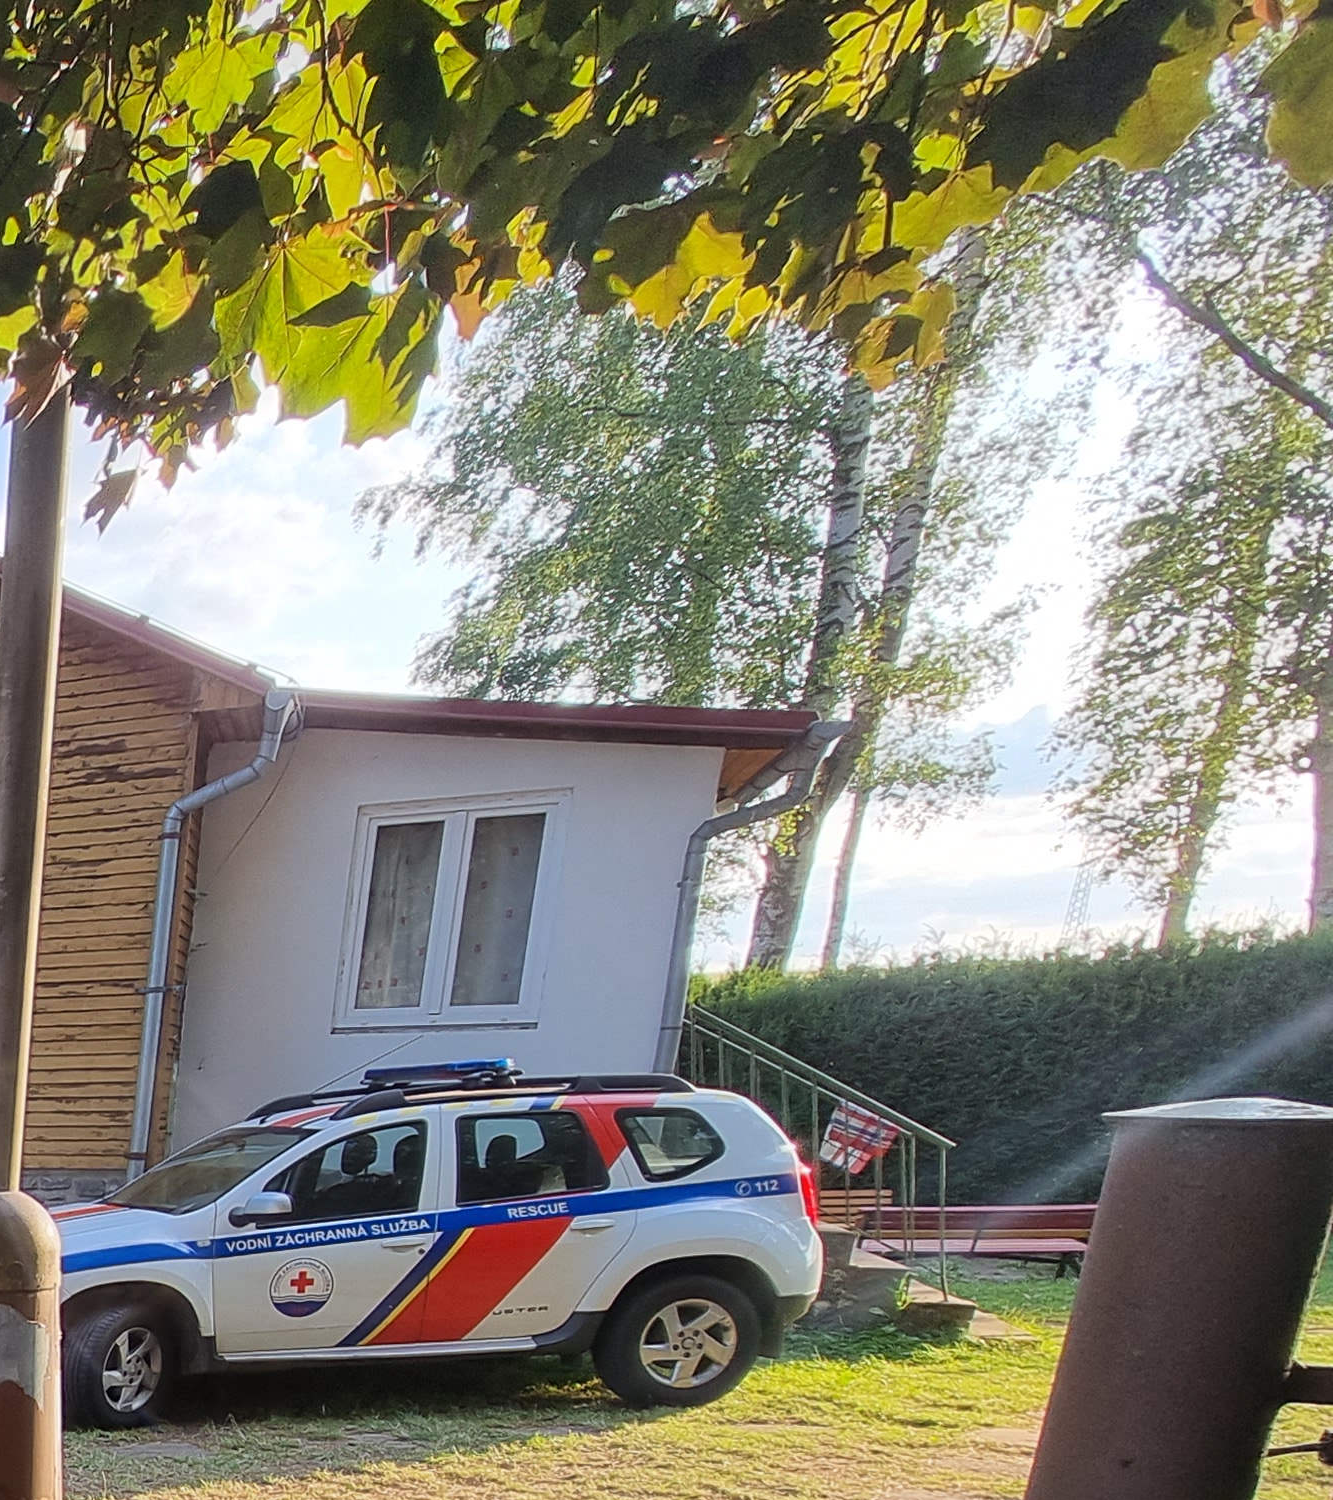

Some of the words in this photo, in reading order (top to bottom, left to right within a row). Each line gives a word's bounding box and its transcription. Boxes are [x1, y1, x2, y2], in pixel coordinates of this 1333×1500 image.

[754, 1179, 779, 1193] 112
[507, 1202, 569, 1219] RESCUE
[225, 1235, 272, 1252] VODNÍ
[275, 1224, 358, 1247] ZÁCHRANNÁ
[370, 1219, 430, 1236] SLUŽBA
